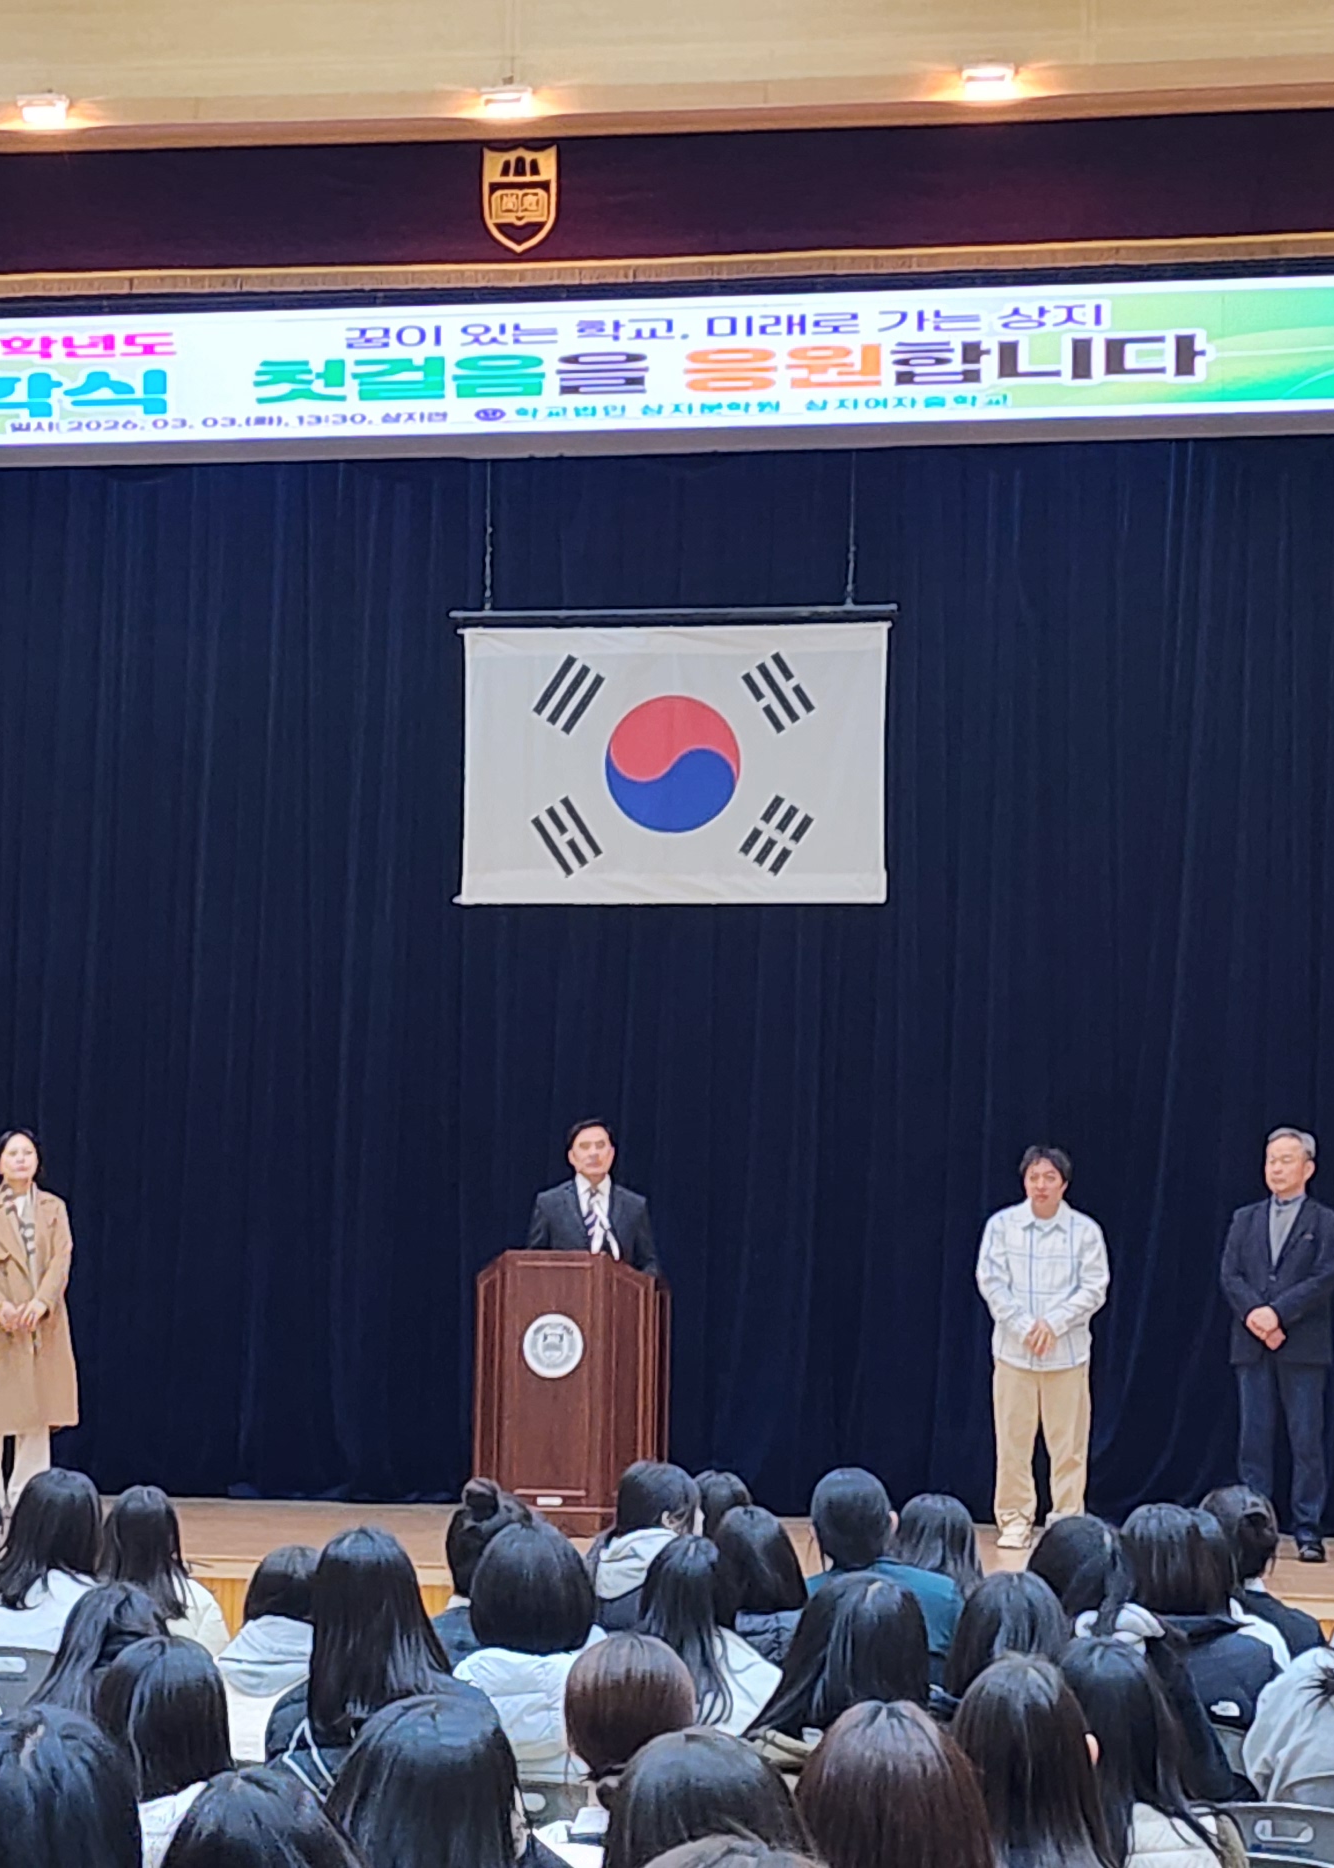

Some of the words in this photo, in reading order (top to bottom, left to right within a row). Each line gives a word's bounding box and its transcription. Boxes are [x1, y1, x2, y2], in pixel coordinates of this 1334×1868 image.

[345, 325, 442, 349] 꿈이
[460, 322, 559, 347] 있는
[705, 310, 861, 337] 미래로
[878, 308, 983, 333] 가는
[998, 302, 1105, 330] 상지
[252, 351, 650, 404] 첫걸음을
[683, 333, 1207, 393] 응원합니다
